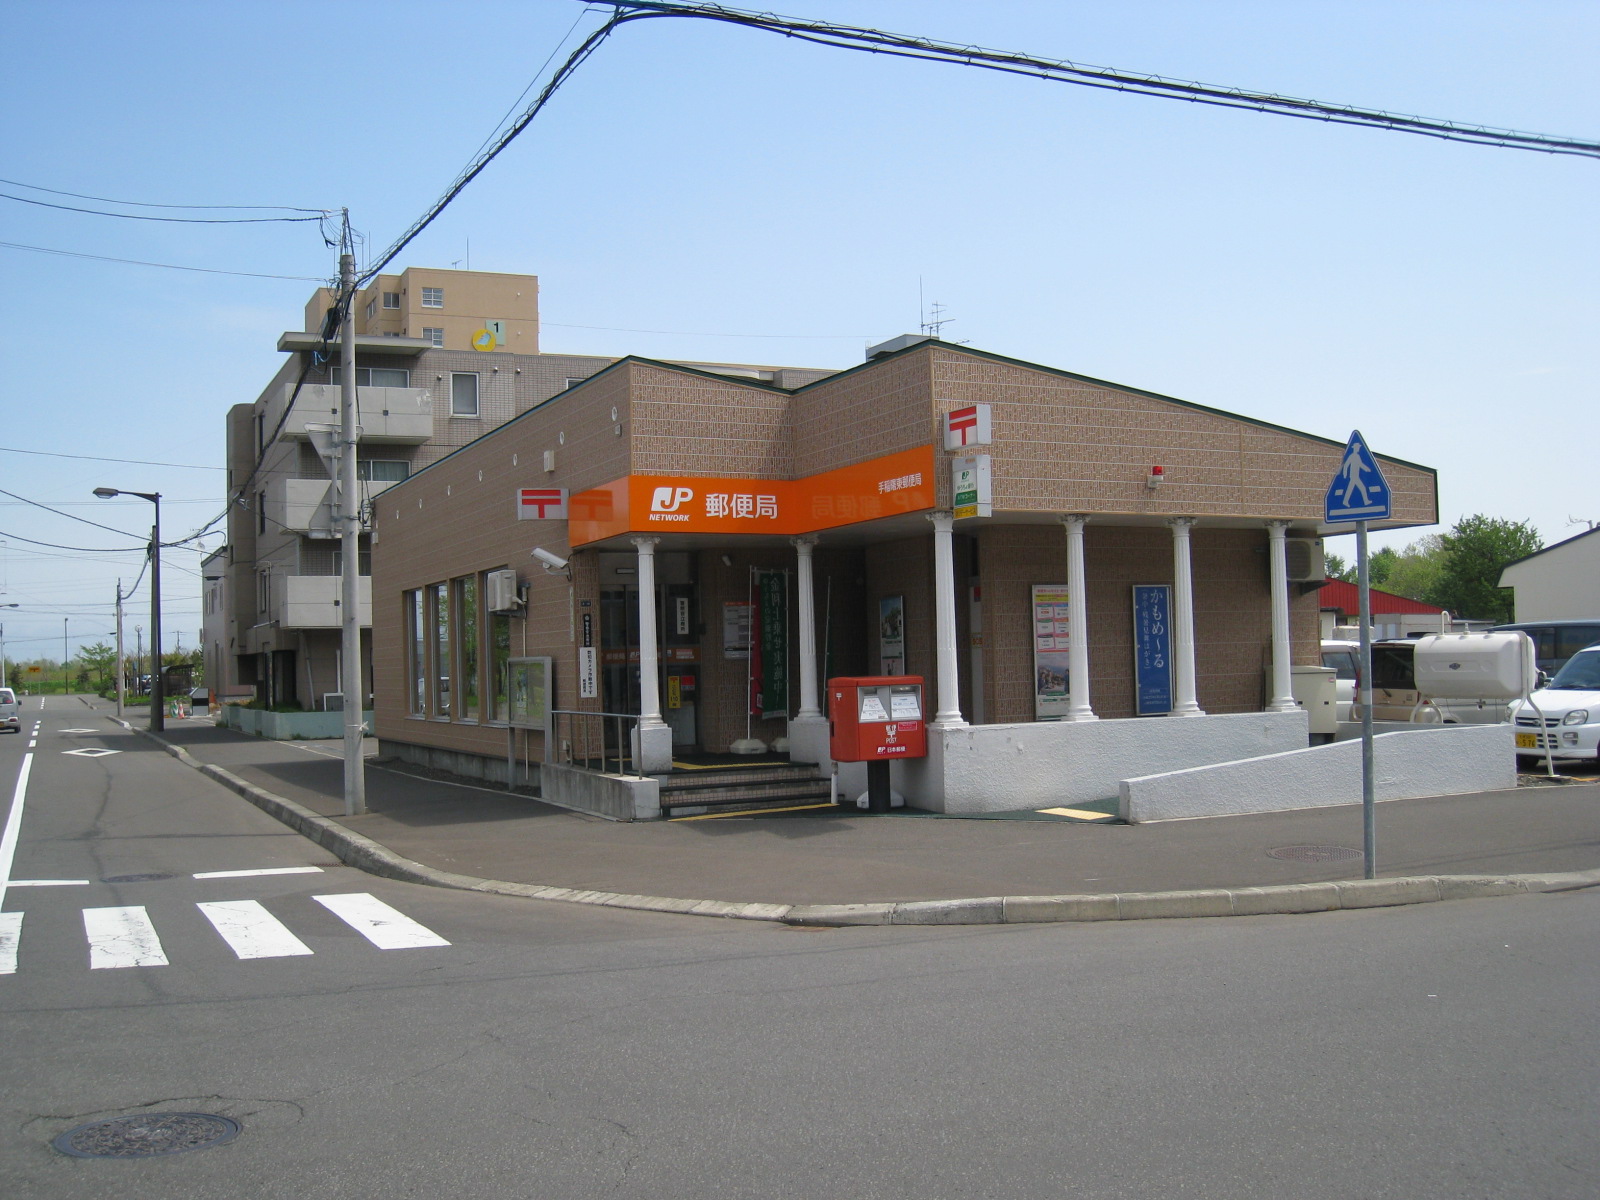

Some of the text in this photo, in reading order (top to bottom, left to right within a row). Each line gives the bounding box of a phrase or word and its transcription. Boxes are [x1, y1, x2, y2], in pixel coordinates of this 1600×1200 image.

[493, 322, 499, 333] 1
[651, 486, 694, 512] JP
[705, 493, 778, 519] 郵便局
[649, 513, 690, 522] NETWORK
